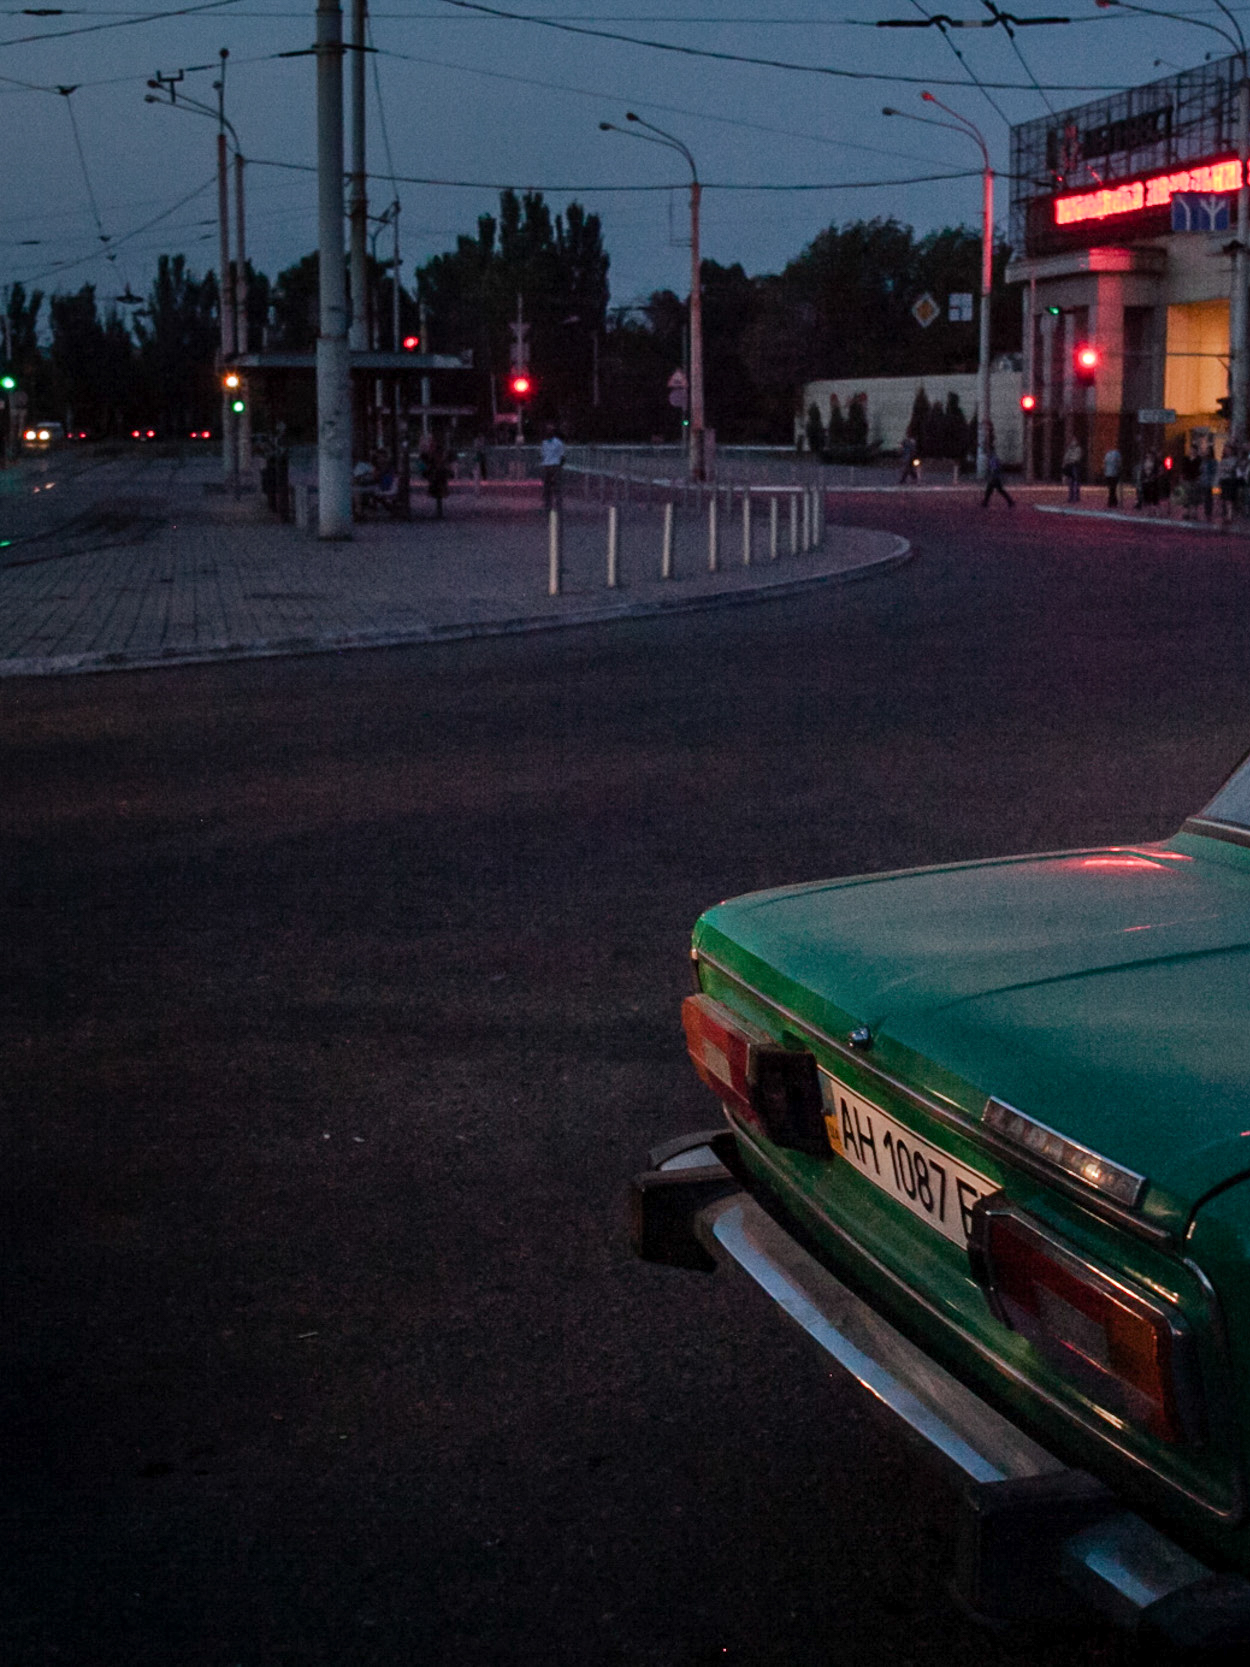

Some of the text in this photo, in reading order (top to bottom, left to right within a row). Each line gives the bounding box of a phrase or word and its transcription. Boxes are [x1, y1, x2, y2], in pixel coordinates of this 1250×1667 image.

[840, 1097, 988, 1241] AH 1087 E
